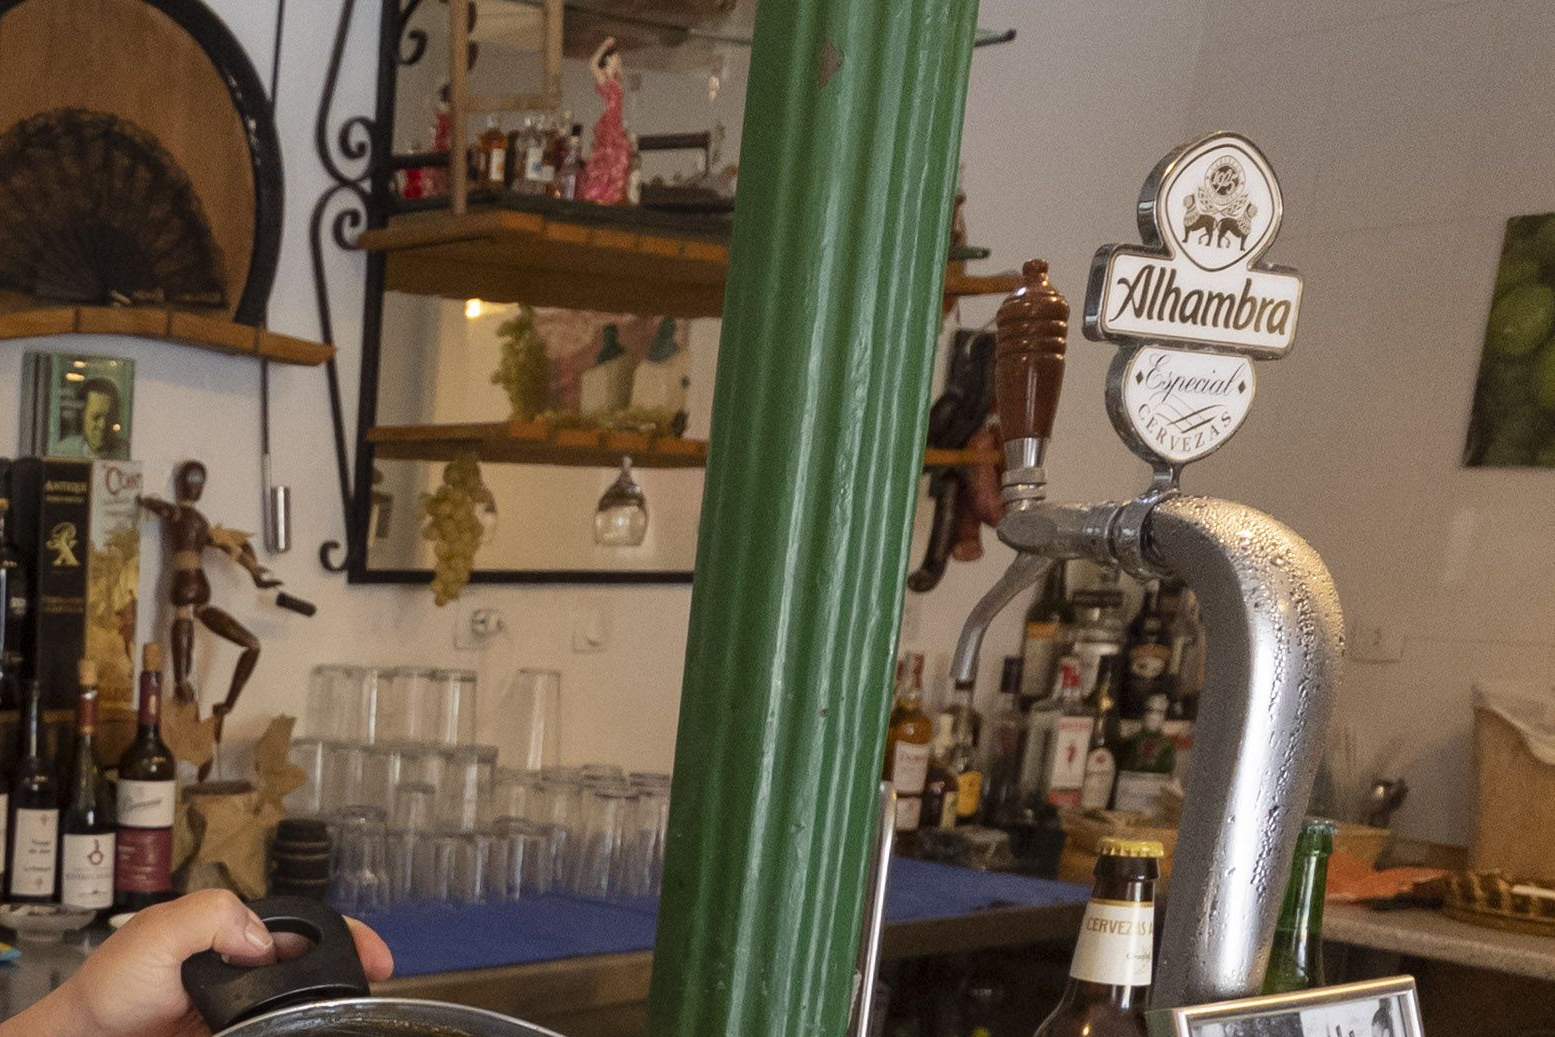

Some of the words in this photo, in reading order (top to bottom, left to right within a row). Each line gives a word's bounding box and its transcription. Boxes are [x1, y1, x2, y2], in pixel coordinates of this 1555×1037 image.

[1211, 167, 1238, 195] 1925
[1111, 264, 1291, 335] Alhambra
[1143, 354, 1239, 402] Especial
[1136, 403, 1234, 453] CERVEZAS
